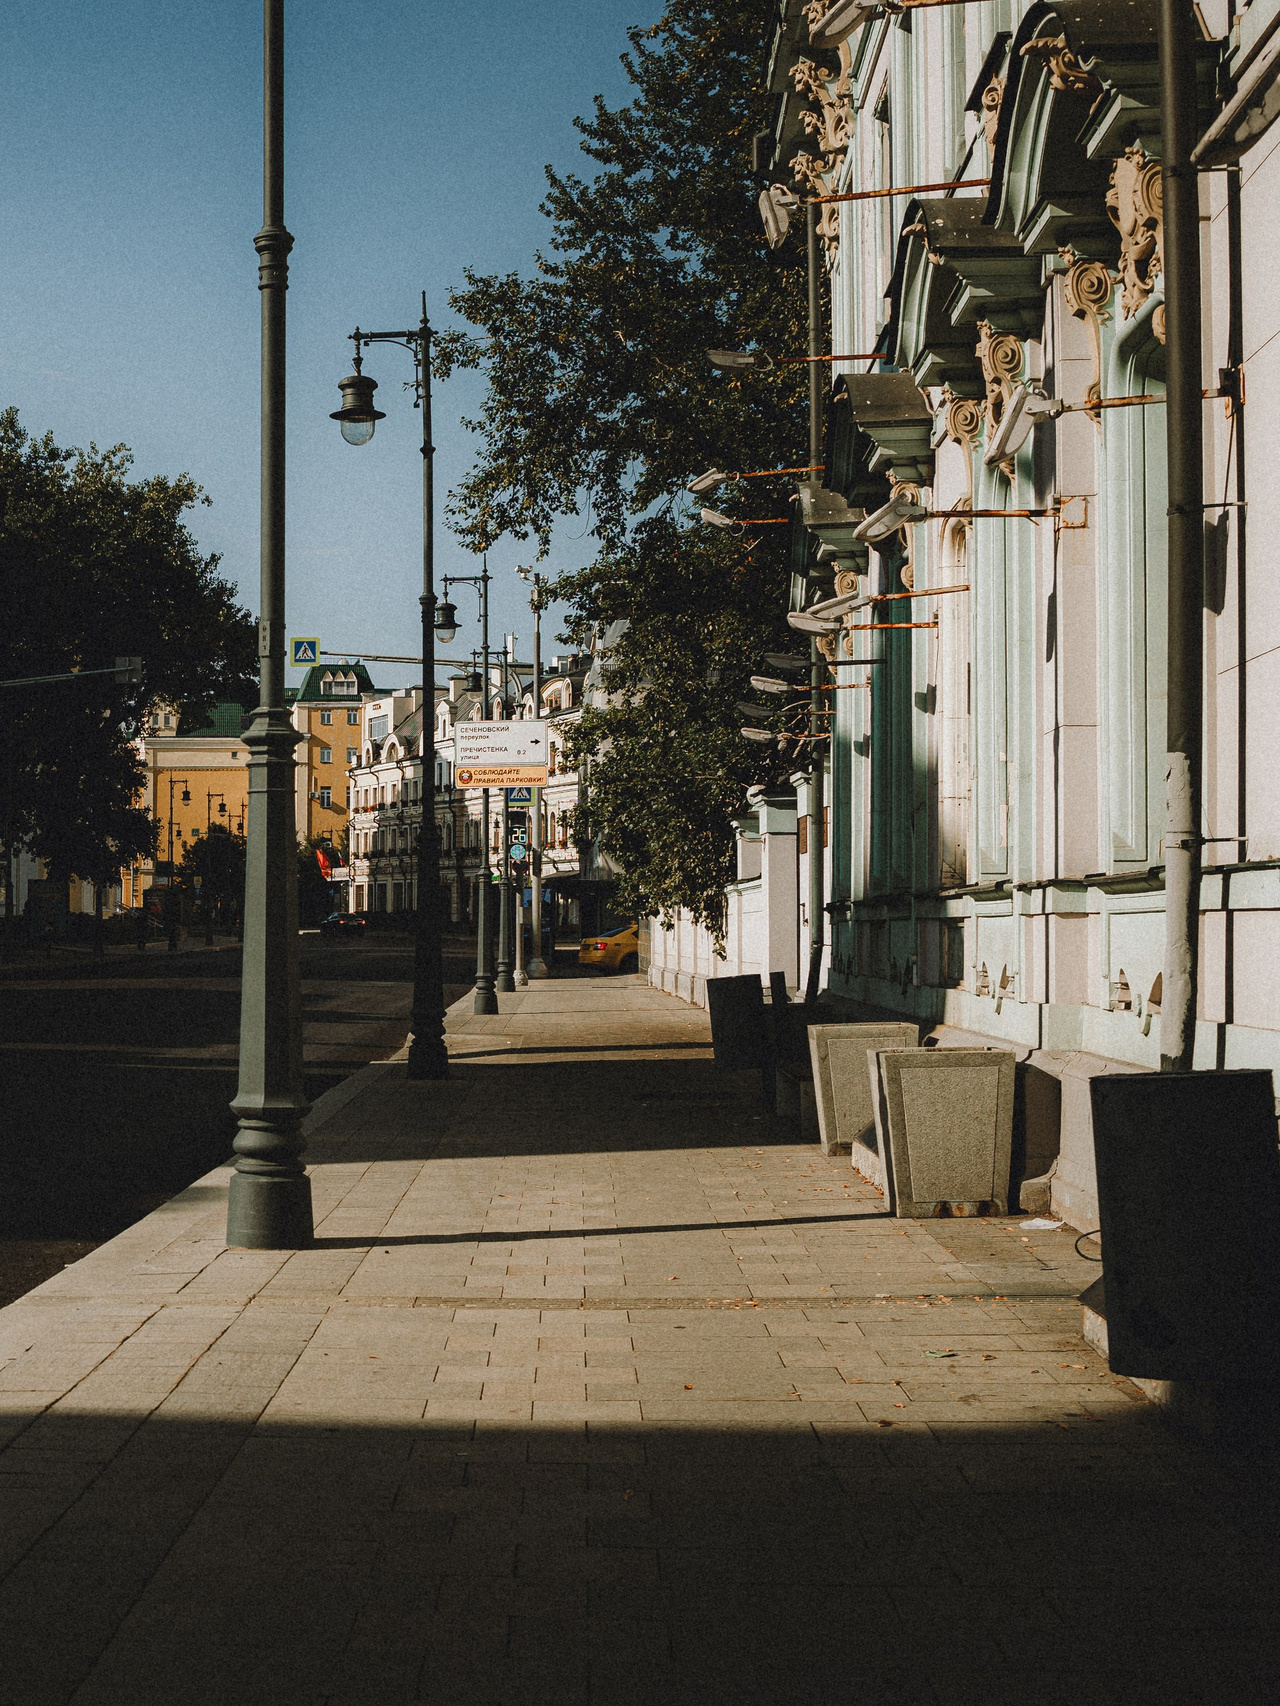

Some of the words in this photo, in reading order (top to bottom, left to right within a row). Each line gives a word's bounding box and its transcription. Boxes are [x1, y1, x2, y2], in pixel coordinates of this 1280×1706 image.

[460, 725, 510, 733] СЕЧЕНОВСКИЙ
[473, 768, 521, 776] СОБЛЮДАЙТЕ
[512, 828, 526, 842] 26
